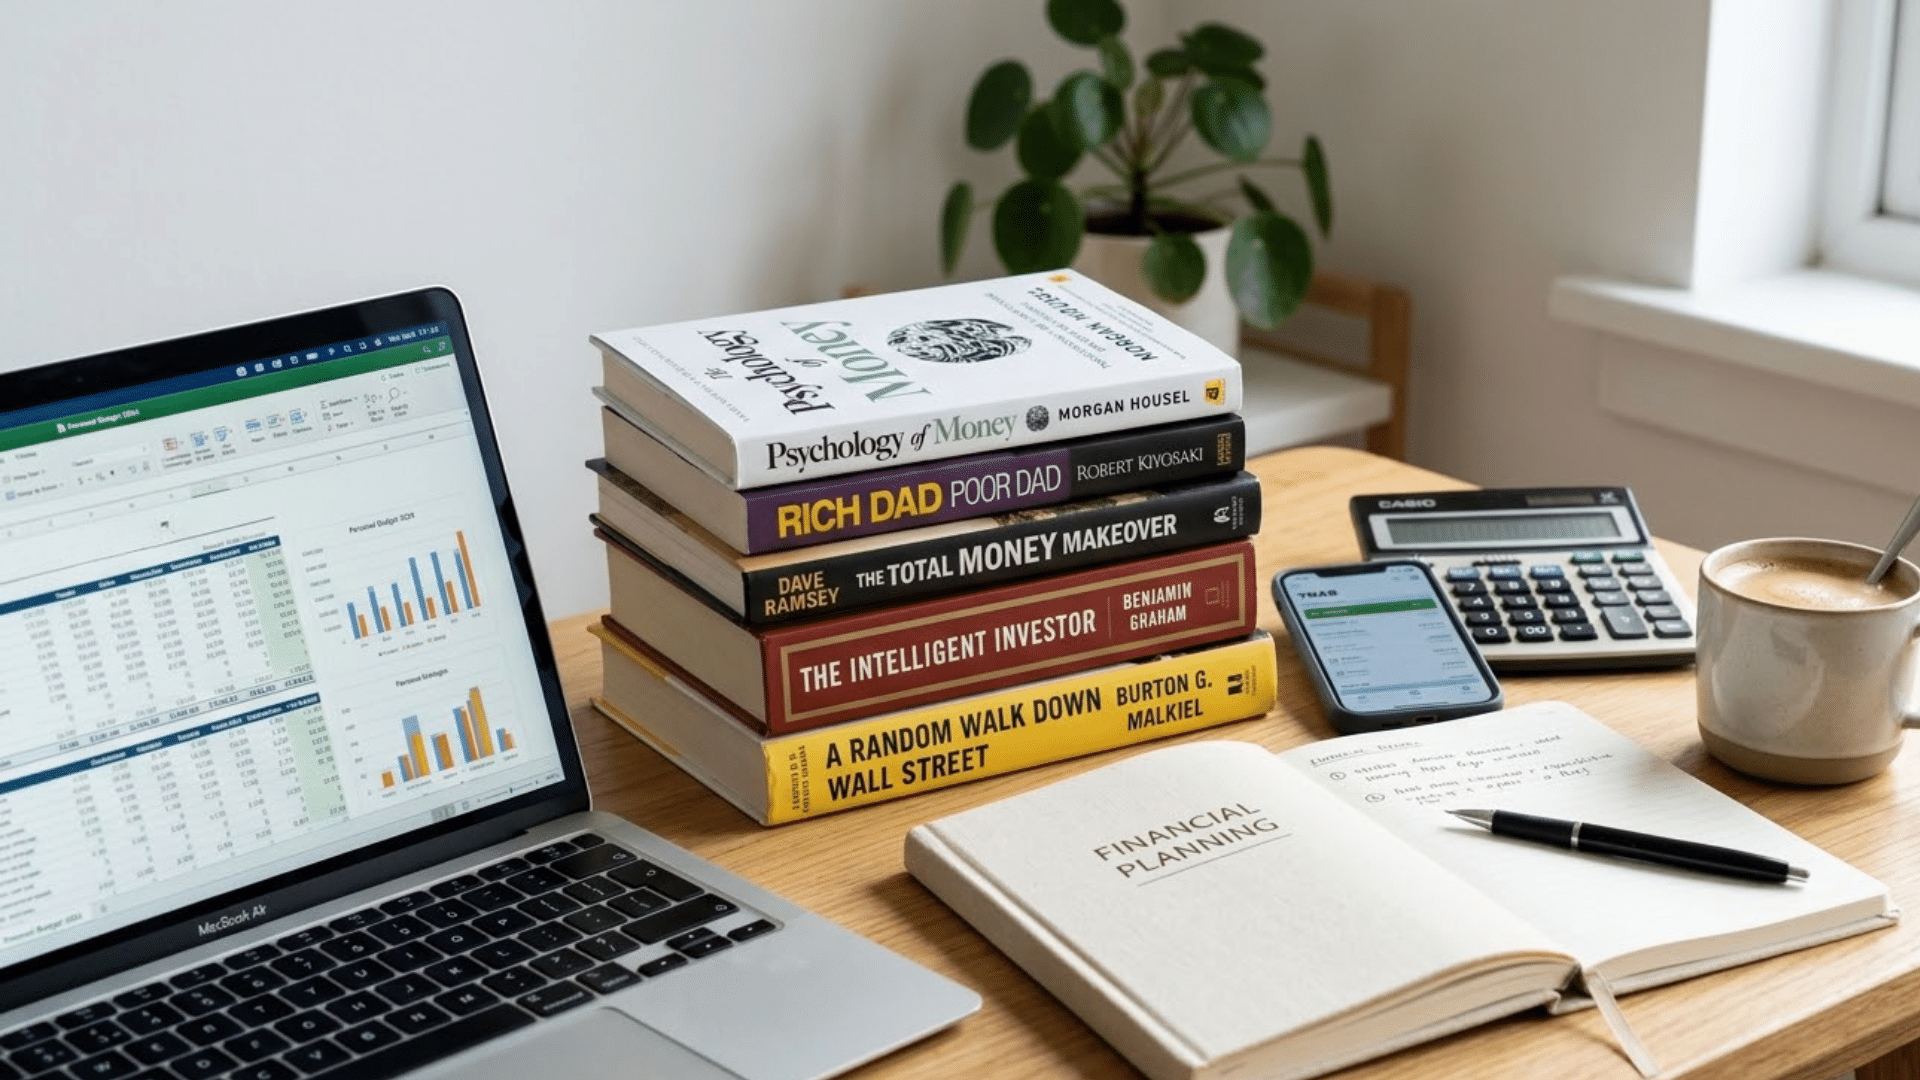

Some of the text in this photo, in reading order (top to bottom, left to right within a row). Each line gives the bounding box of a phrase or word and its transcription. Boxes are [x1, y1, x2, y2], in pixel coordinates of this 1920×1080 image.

[697, 330, 836, 415] Psychology
[780, 321, 931, 403] Money
[1059, 390, 1191, 422] MORGAN HOUSEL
[767, 415, 1017, 473] Psychology of Money
[1077, 458, 1133, 481] ROBERT
[1138, 447, 1203, 471] KIYOSAKI
[777, 464, 1061, 539] RICH DAD POOR DAD
[1377, 498, 1437, 509] CASIO
[856, 513, 1177, 589] THE TOTAL MONEY MAKEOVER
[764, 586, 841, 616] RAMSEY
[778, 570, 825, 592] DAVE
[1122, 582, 1193, 610] BENJAMIN
[1129, 606, 1188, 631] GRAHAM
[799, 610, 1097, 693] THE INTELLIGENT INVESTOR
[1116, 677, 1187, 707] BURTON
[1195, 669, 1213, 691] G.
[1127, 698, 1205, 733] MALKIEL
[825, 687, 1102, 770] A RANDOM WALK DOWN
[826, 772, 896, 802] WALL
[901, 745, 991, 787] STREET
[1093, 802, 1262, 862] FINANCIAL
[1114, 817, 1280, 880] PLANNING
